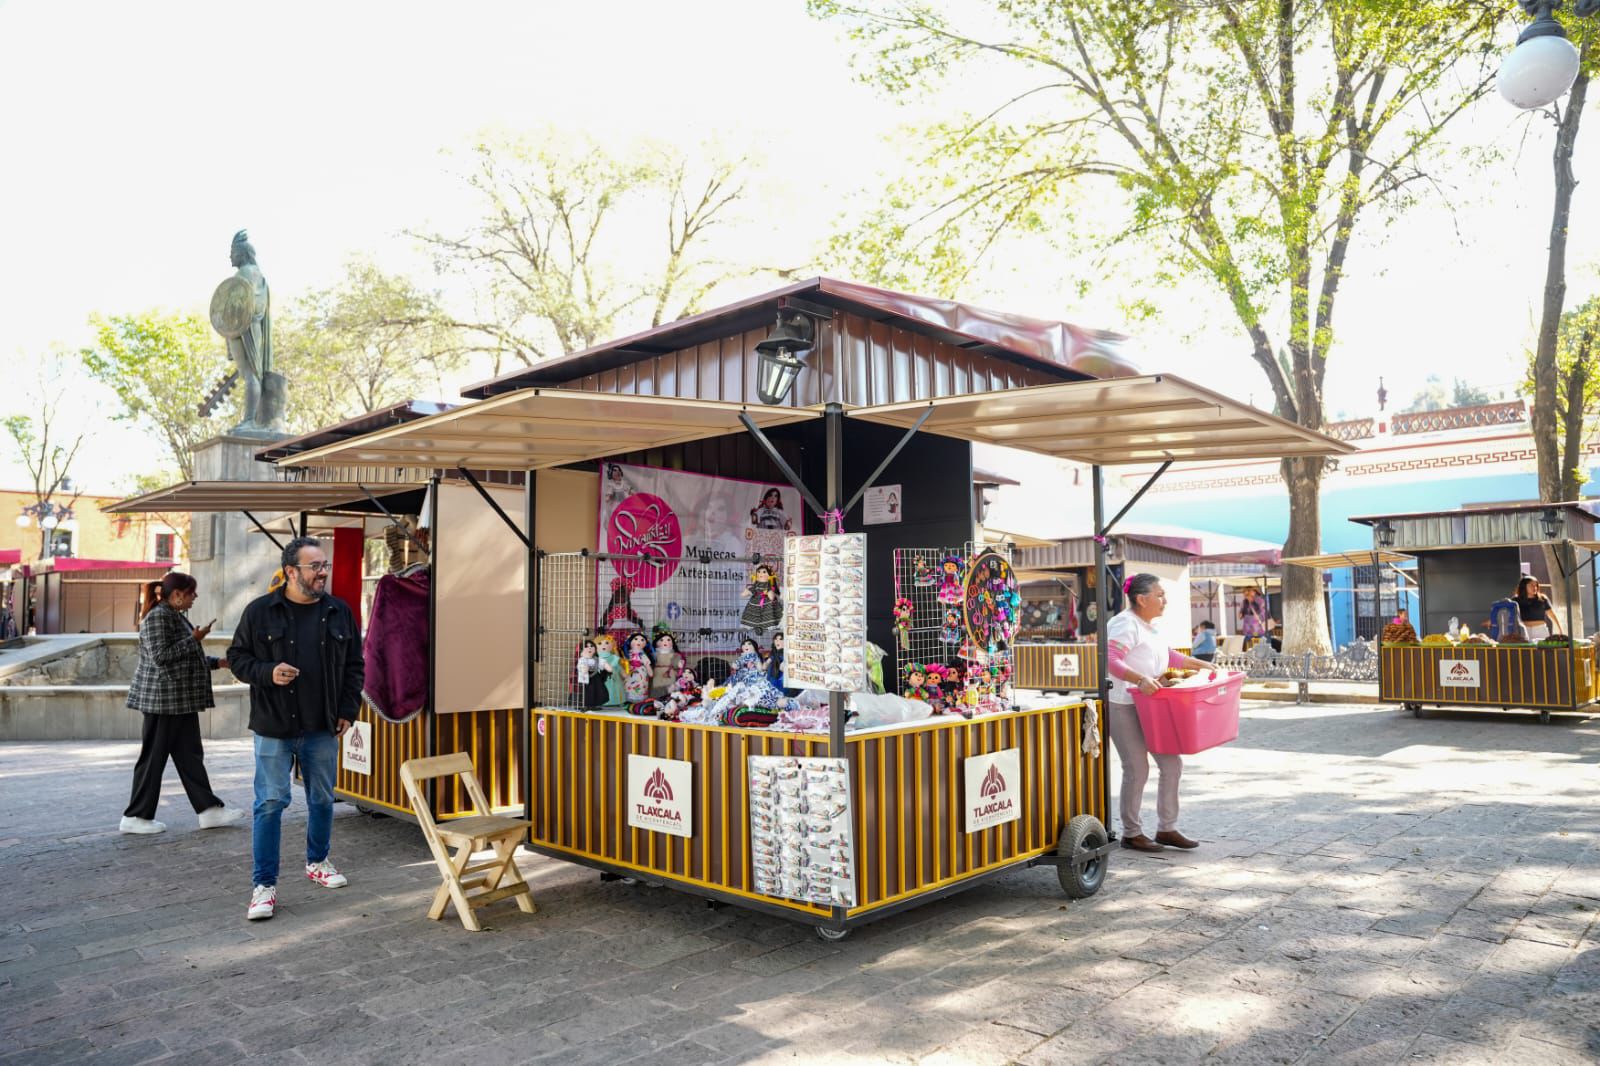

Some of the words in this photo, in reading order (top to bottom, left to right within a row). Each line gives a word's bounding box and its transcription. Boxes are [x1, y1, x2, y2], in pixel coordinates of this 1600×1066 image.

[686, 545, 736, 559] Muñecas
[678, 566, 743, 580] Artesanales
[636, 804, 682, 822] TLAXCALA
[973, 798, 1012, 818] TLAXCALA
